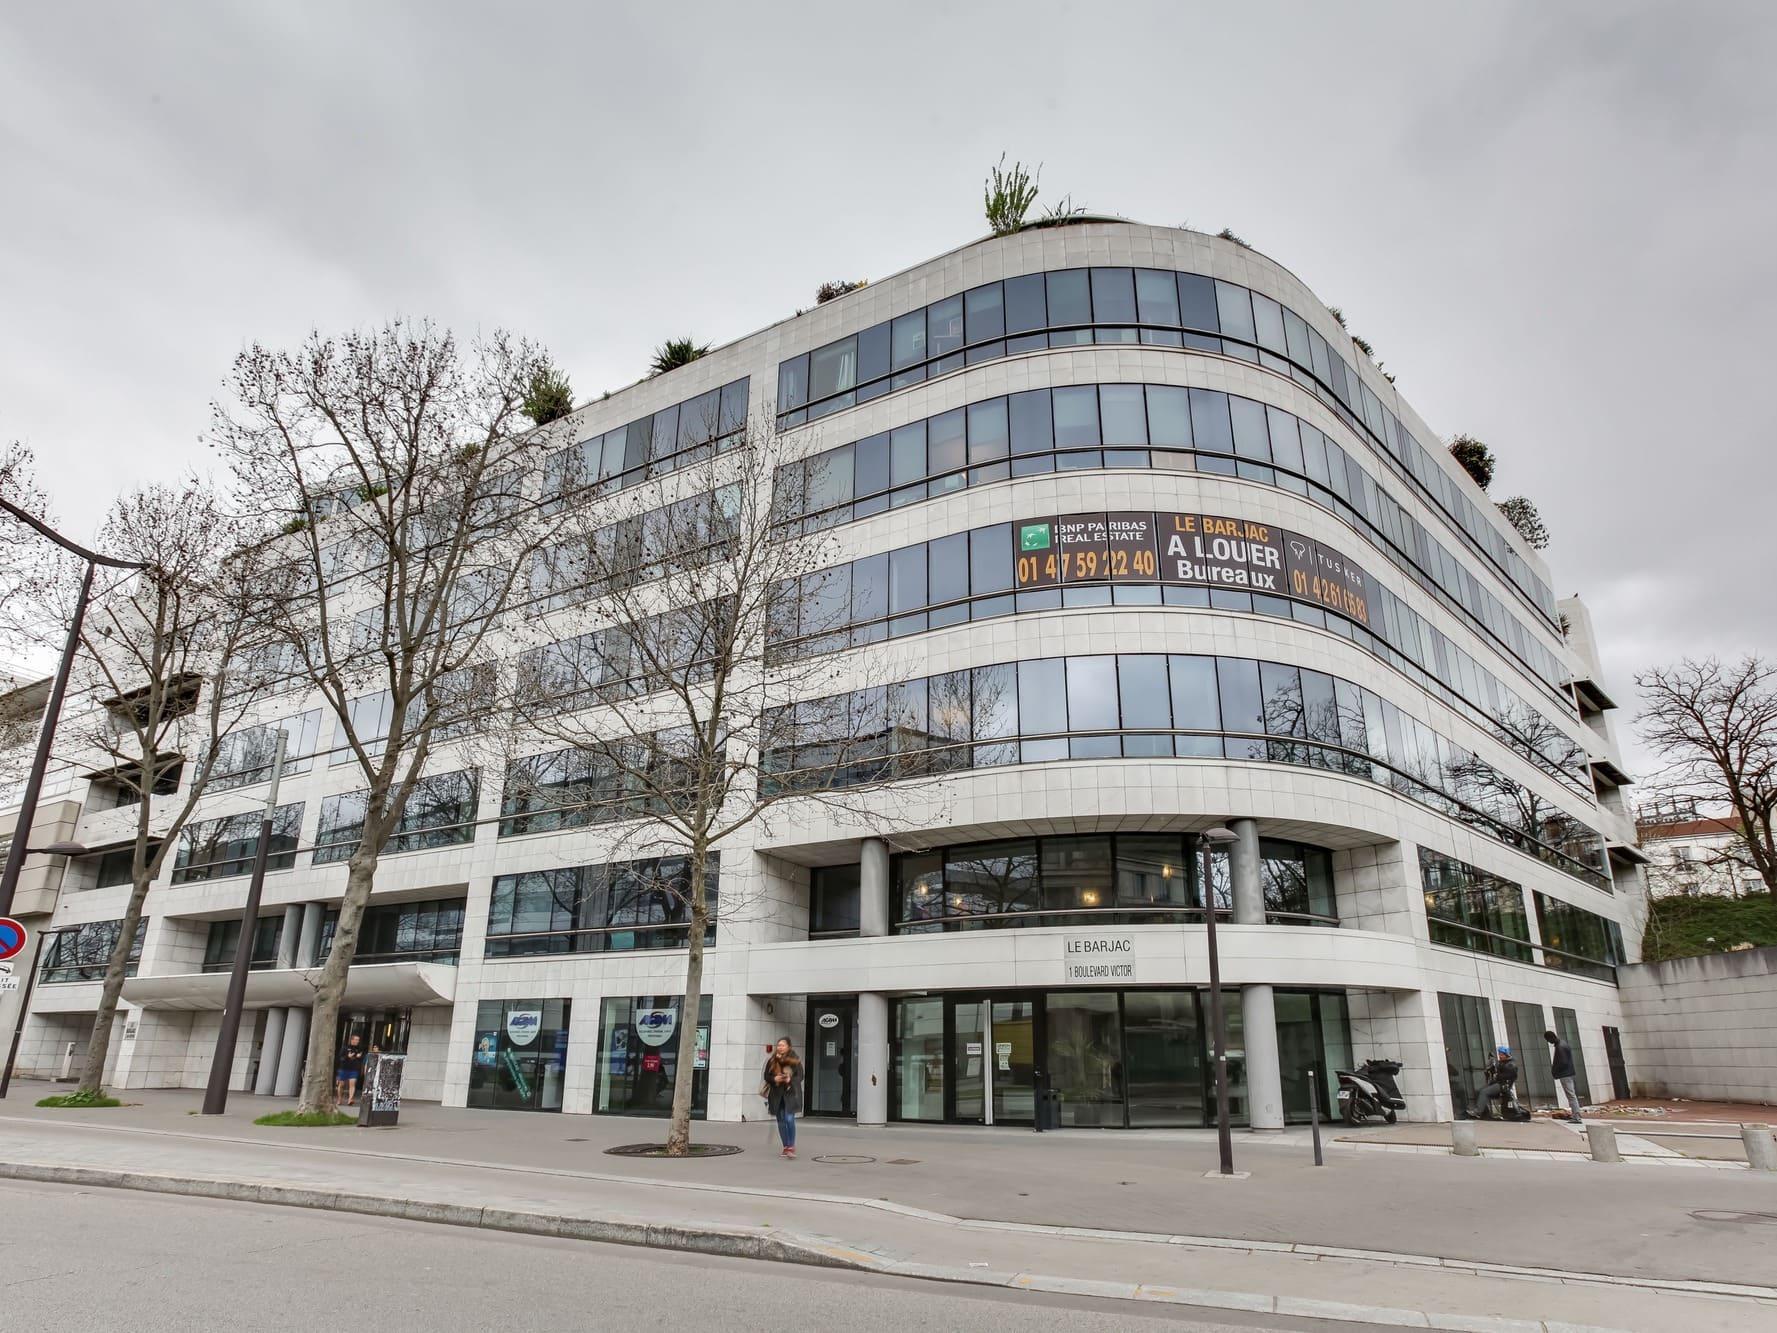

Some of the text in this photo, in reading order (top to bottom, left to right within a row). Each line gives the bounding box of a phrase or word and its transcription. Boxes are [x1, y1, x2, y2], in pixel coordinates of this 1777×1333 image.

[1054, 521, 1147, 534] BNP PARIBAS
[1055, 531, 1144, 543] REAL ESTATE
[1174, 515, 1269, 542] LE BARJAC
[1018, 550, 1154, 583] 01 47 59 22 40
[1167, 534, 1281, 570] A LOUER
[1176, 559, 1277, 590] Bureaux
[1317, 553, 1362, 587] TUSKER
[1293, 569, 1308, 595] 01
[1312, 575, 1330, 602] 42
[1330, 582, 1342, 608] 61
[1067, 940, 1131, 953] LE BARJAC
[1068, 964, 1133, 978] 1 BOULEVARD VICTOR
